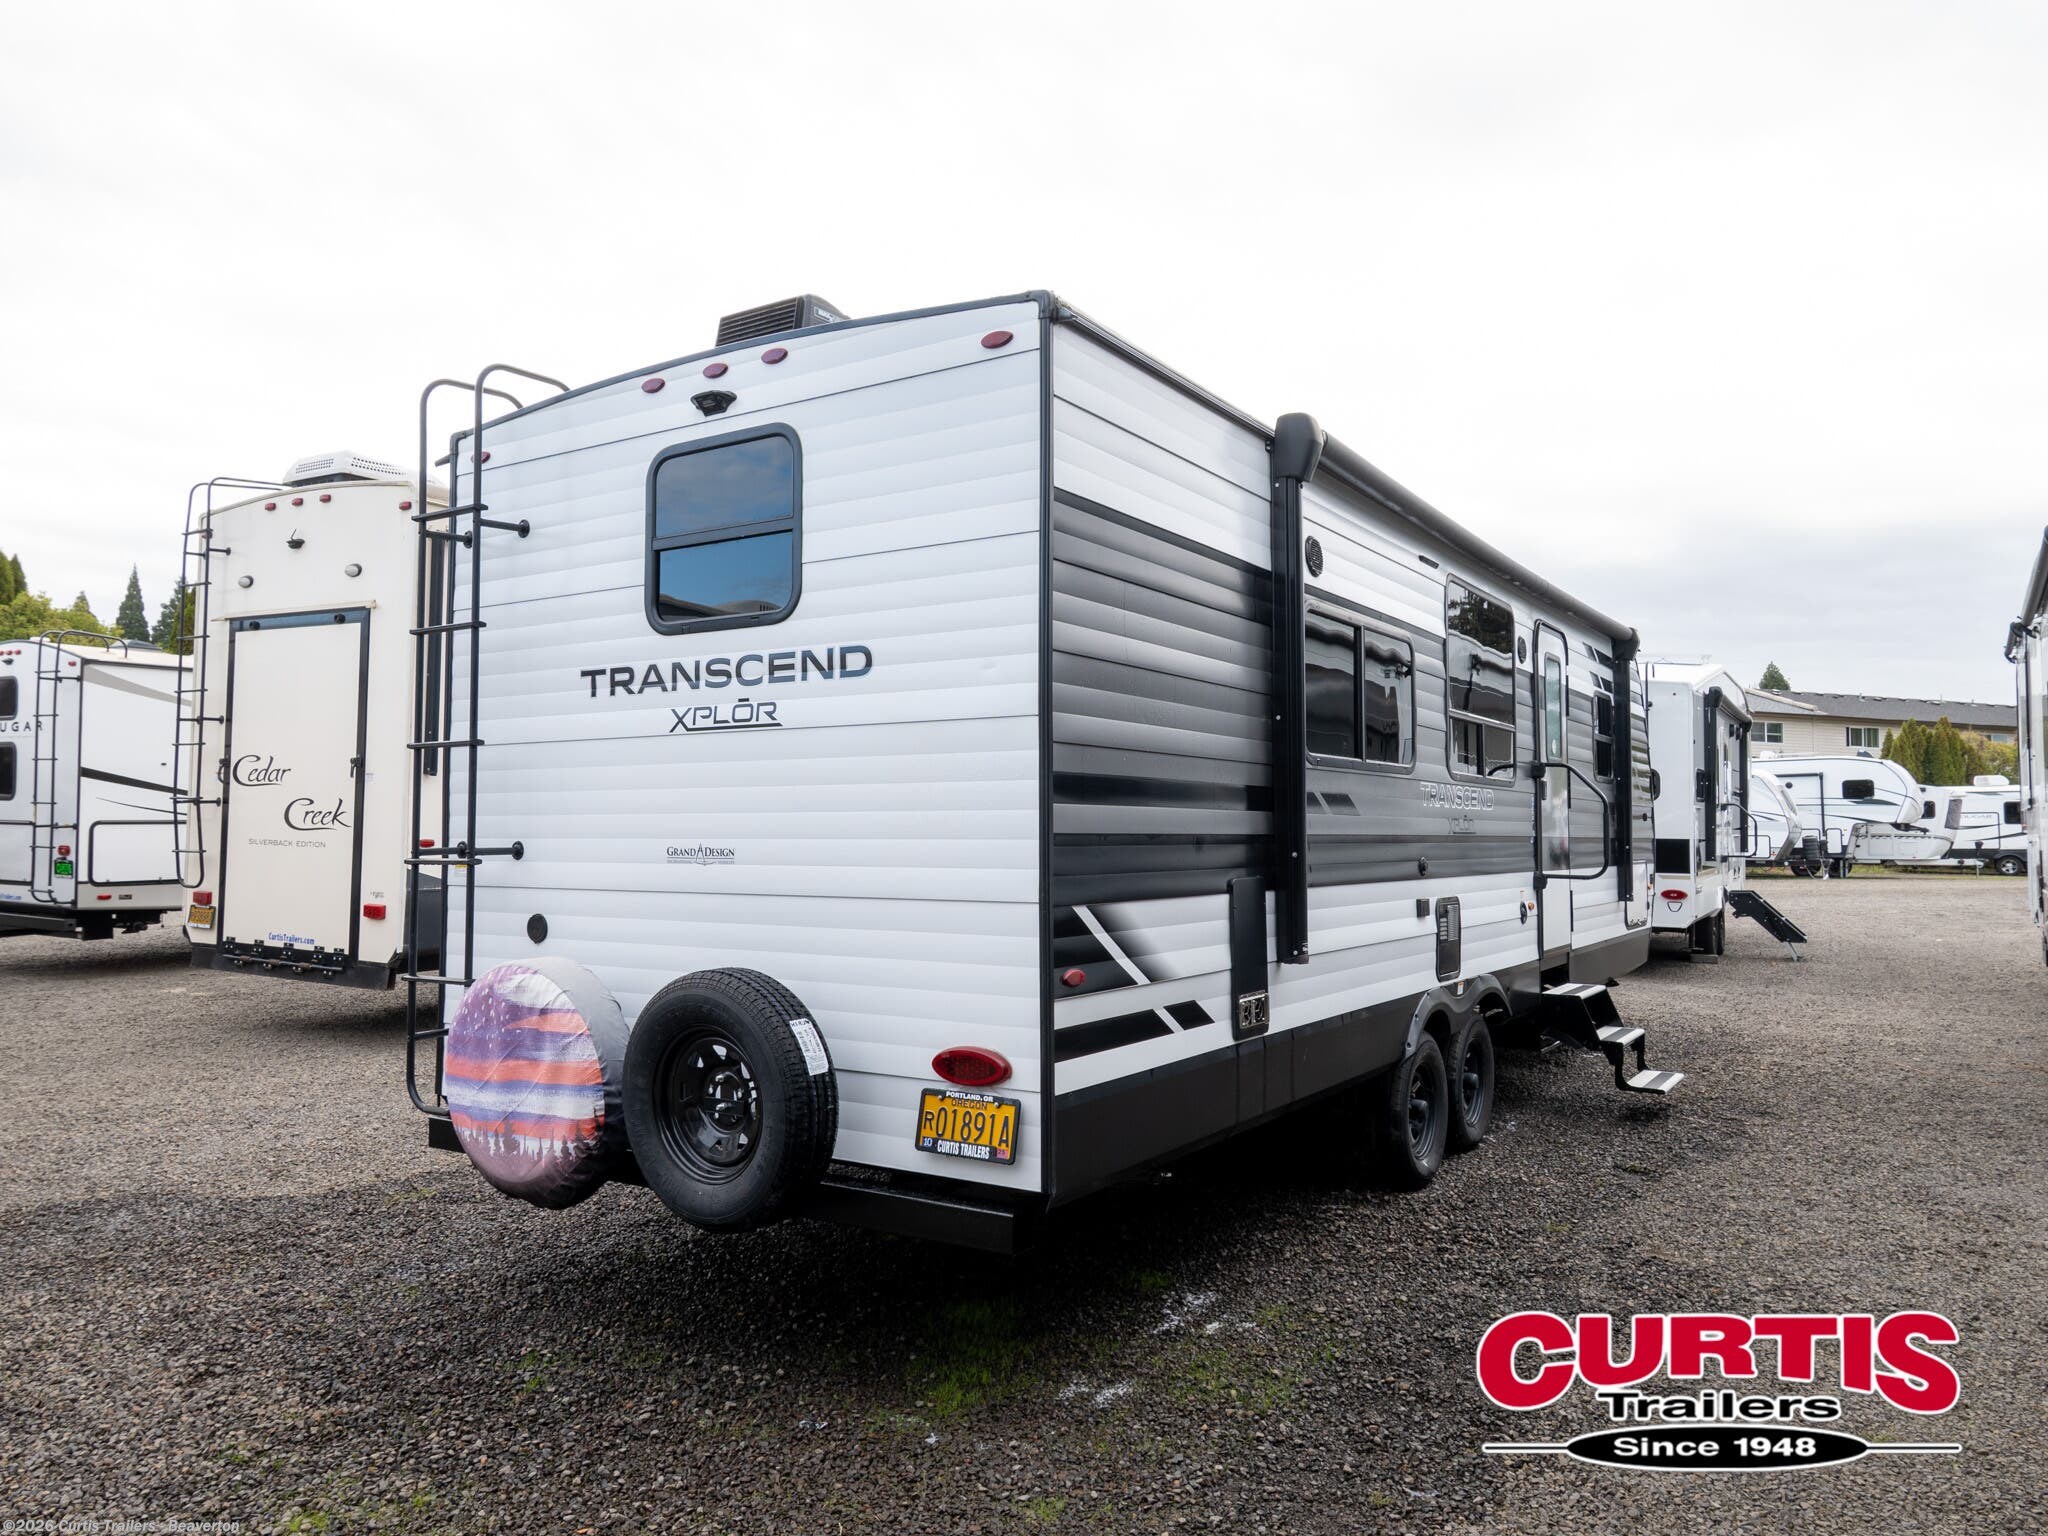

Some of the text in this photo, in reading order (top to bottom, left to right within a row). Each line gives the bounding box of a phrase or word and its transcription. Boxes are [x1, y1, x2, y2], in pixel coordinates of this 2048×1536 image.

[581, 644, 872, 698] TRANSCEND
[232, 754, 292, 787] Cedar
[1420, 781, 1494, 811] TRANSCEND
[284, 797, 352, 831] Creek
[248, 838, 326, 849] SILVERBACK EDITION
[666, 846, 735, 857] GRAND DESIGN
[923, 1107, 1009, 1148] R01891A
[937, 1139, 960, 1155] CURTIS
[960, 1143, 990, 1159] TRAILERS
